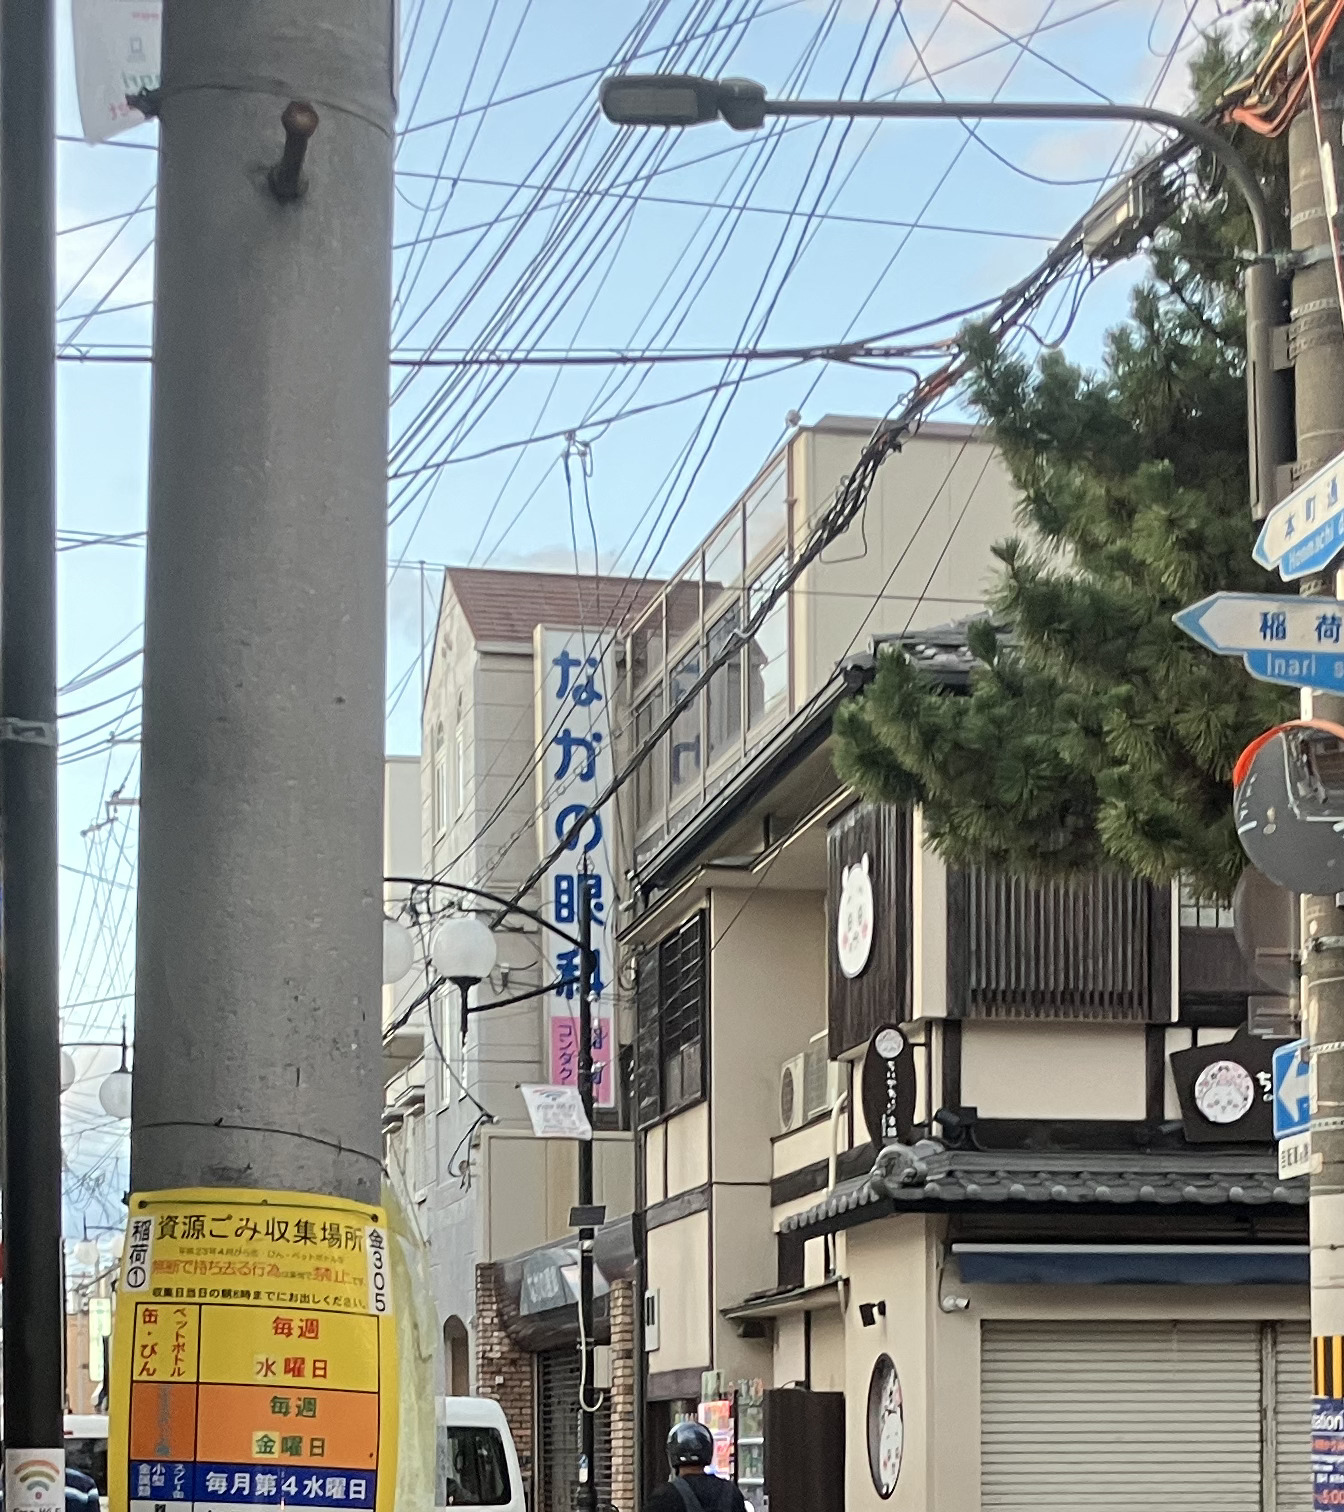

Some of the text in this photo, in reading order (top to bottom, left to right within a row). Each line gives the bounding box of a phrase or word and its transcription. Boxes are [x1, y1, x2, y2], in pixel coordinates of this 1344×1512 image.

[1266, 652, 1316, 677] Inari
[156, 1213, 363, 1253] 資源ごみ収集場所
[272, 1316, 320, 1340] 毎週
[256, 1356, 328, 1380] 水曜日
[269, 1395, 318, 1418] 毎週
[254, 1434, 326, 1458] 金曜日
[205, 1471, 368, 1501] 毎月第4水曜日
